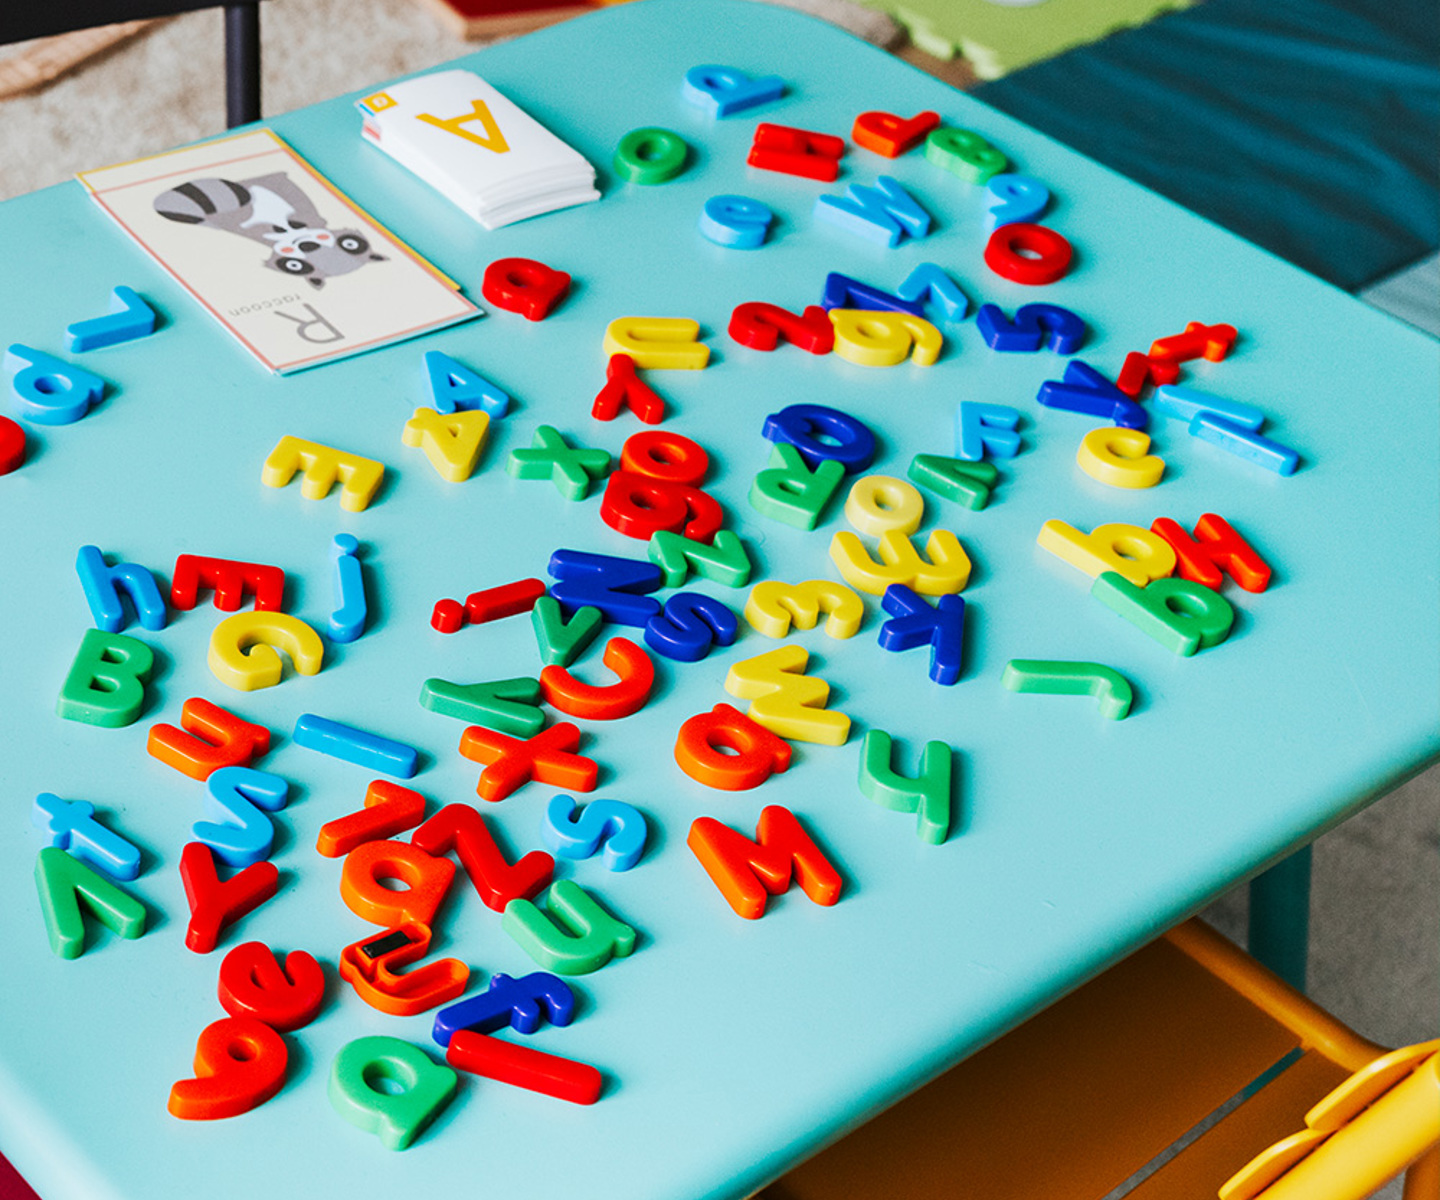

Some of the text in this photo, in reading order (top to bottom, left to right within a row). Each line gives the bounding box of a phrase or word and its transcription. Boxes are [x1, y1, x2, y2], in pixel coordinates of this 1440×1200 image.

[415, 100, 510, 154] A
[229, 294, 300, 317] raccoon
[274, 303, 345, 344] R
[422, 350, 509, 420] A
[261, 435, 384, 511] E
[401, 407, 491, 483] A
[748, 442, 846, 531] R
[75, 545, 167, 634] h
[170, 553, 285, 612] E
[327, 533, 367, 643] j
[1150, 513, 1271, 593] H
[57, 628, 154, 728] B
[207, 610, 324, 692] G
[178, 842, 279, 954] Y
[687, 805, 842, 920] M
[217, 941, 325, 1033] e
